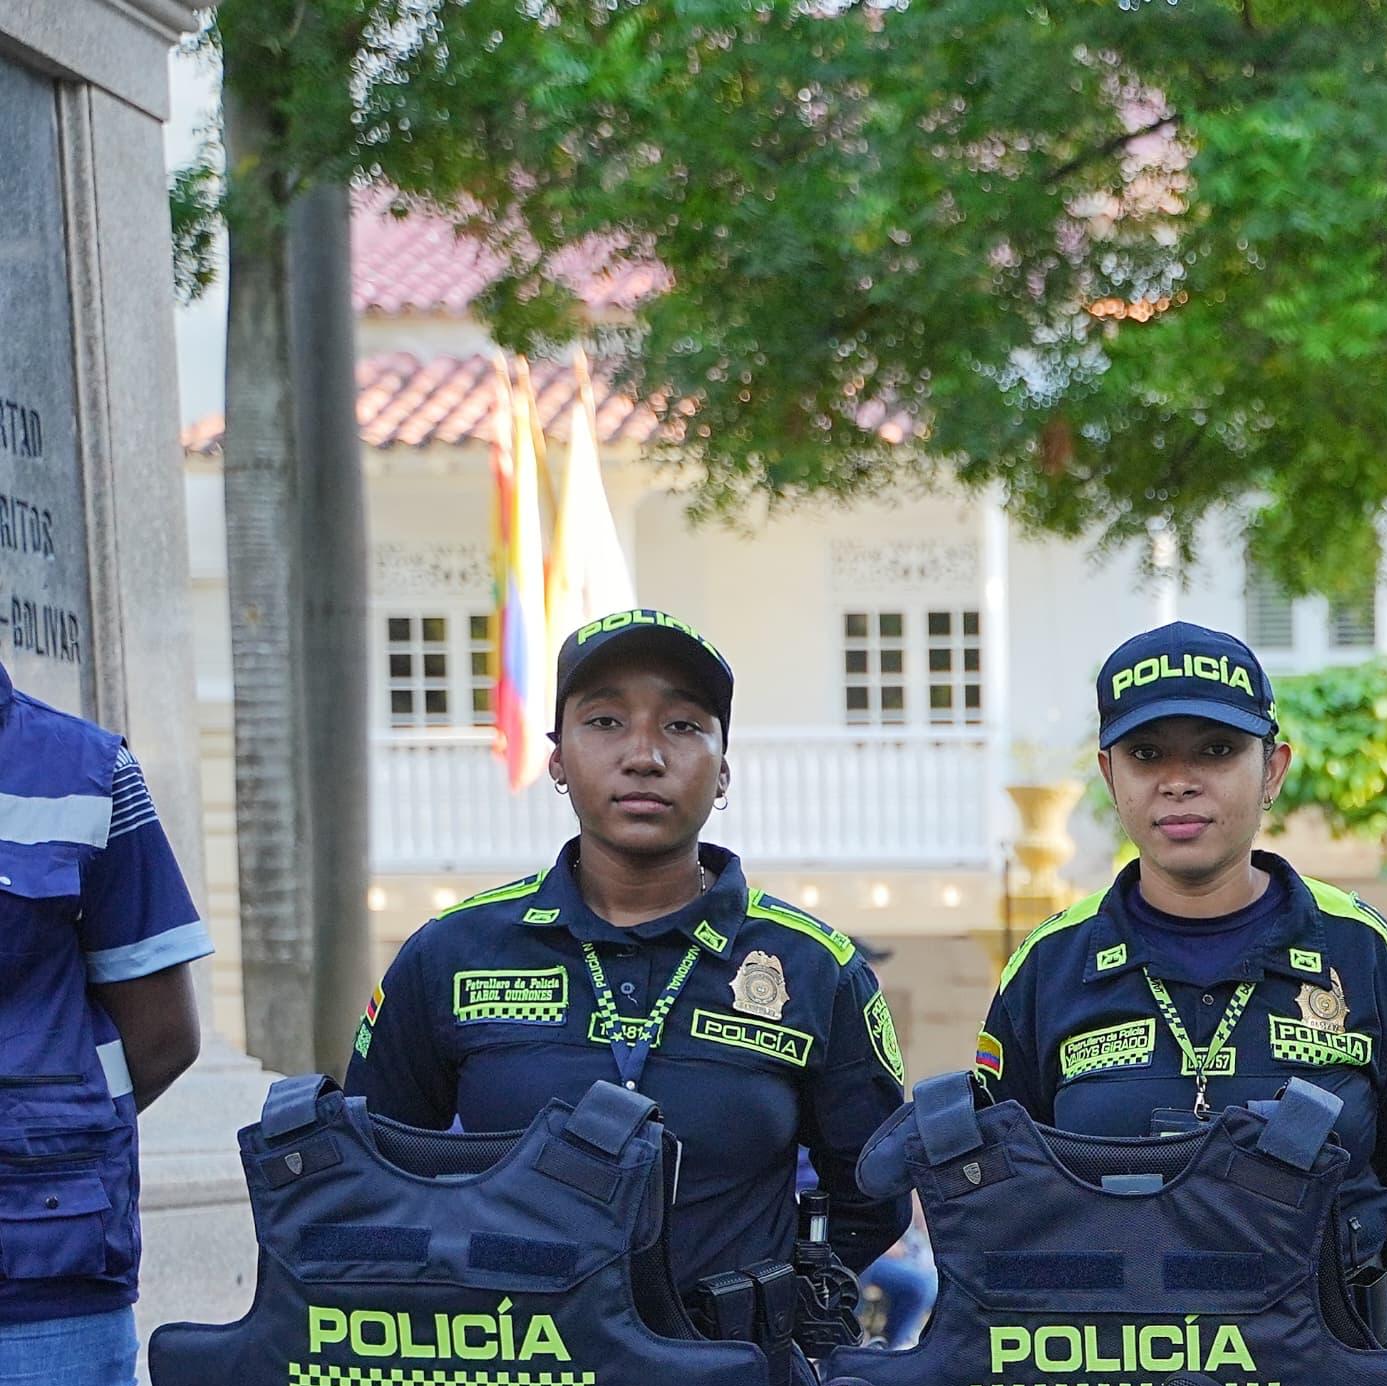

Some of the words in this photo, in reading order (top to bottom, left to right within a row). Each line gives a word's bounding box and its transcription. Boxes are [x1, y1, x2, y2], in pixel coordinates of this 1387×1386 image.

[1112, 654, 1254, 700] POLICÍA
[666, 944, 700, 991] NACIONAL
[705, 1020, 798, 1058] POLICÍA
[1101, 1036, 1148, 1054] GIRADO
[308, 1297, 571, 1362] POLICÍA
[989, 1314, 1257, 1374] POLICÍA
